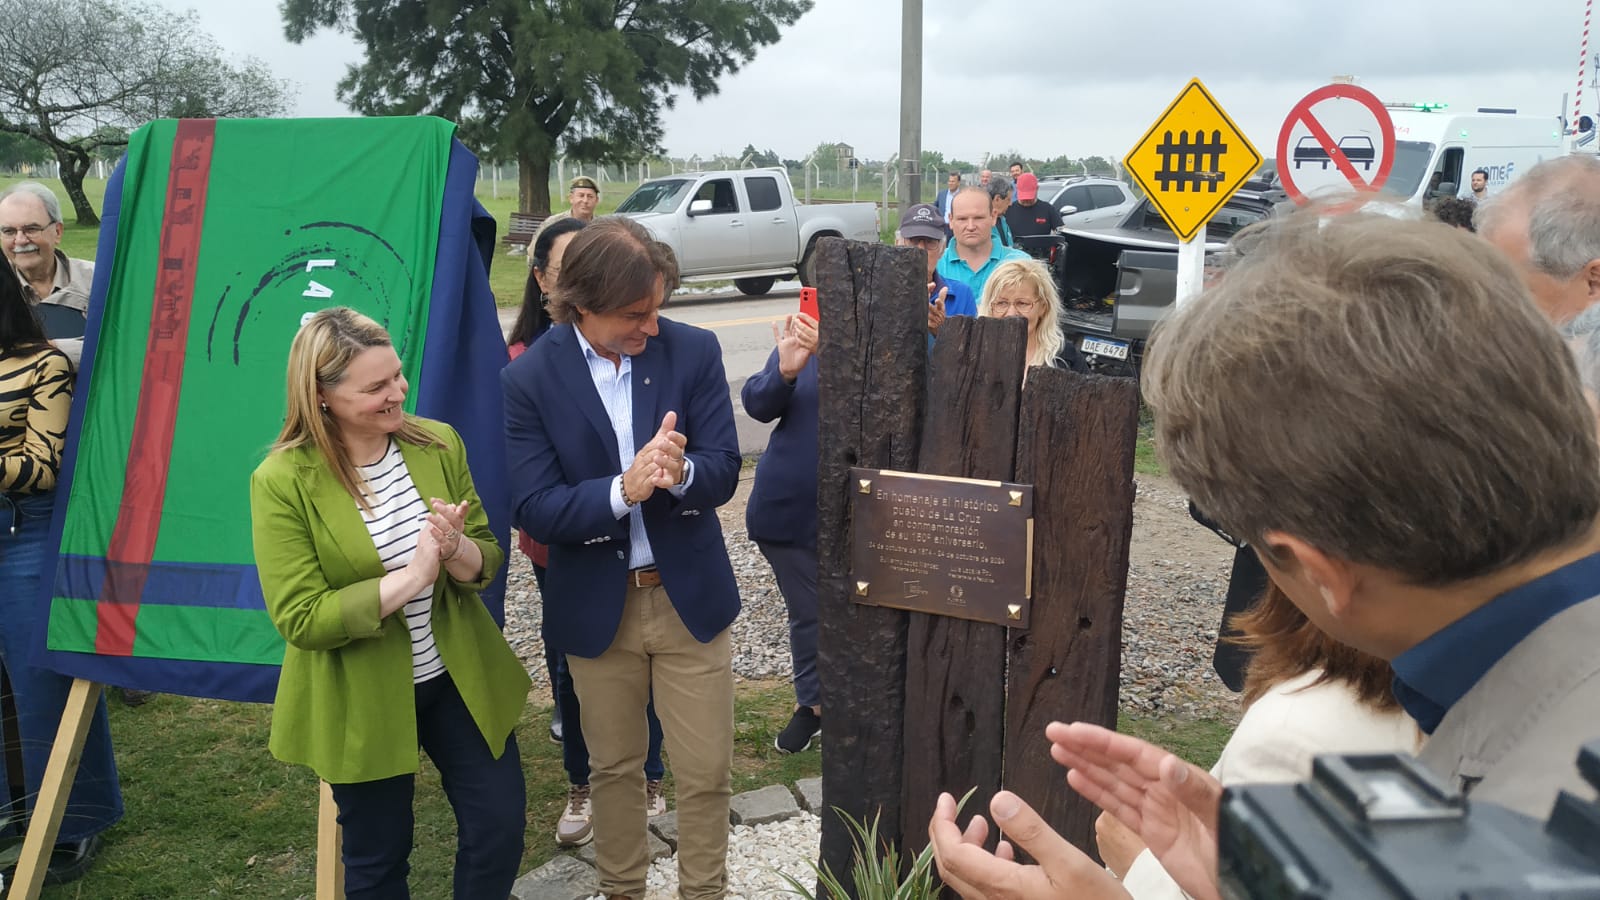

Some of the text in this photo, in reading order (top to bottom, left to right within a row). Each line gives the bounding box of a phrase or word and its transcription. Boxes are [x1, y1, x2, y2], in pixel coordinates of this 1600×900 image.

[1103, 343, 1125, 357] 6476
[876, 489, 999, 512] En homenaje al histórico
[892, 505, 981, 524] pueblo de La Cruz
[893, 519, 979, 537] en conmemoración
[885, 528, 896, 539] de
[898, 532, 909, 541] su
[934, 534, 987, 550] aniversario.
[877, 542, 884, 550] de
[885, 544, 907, 553] octubre
[909, 546, 917, 554] de
[946, 551, 954, 559] de
[955, 553, 979, 562] octubre
[980, 555, 989, 563] de
[990, 556, 1005, 565] 2024
